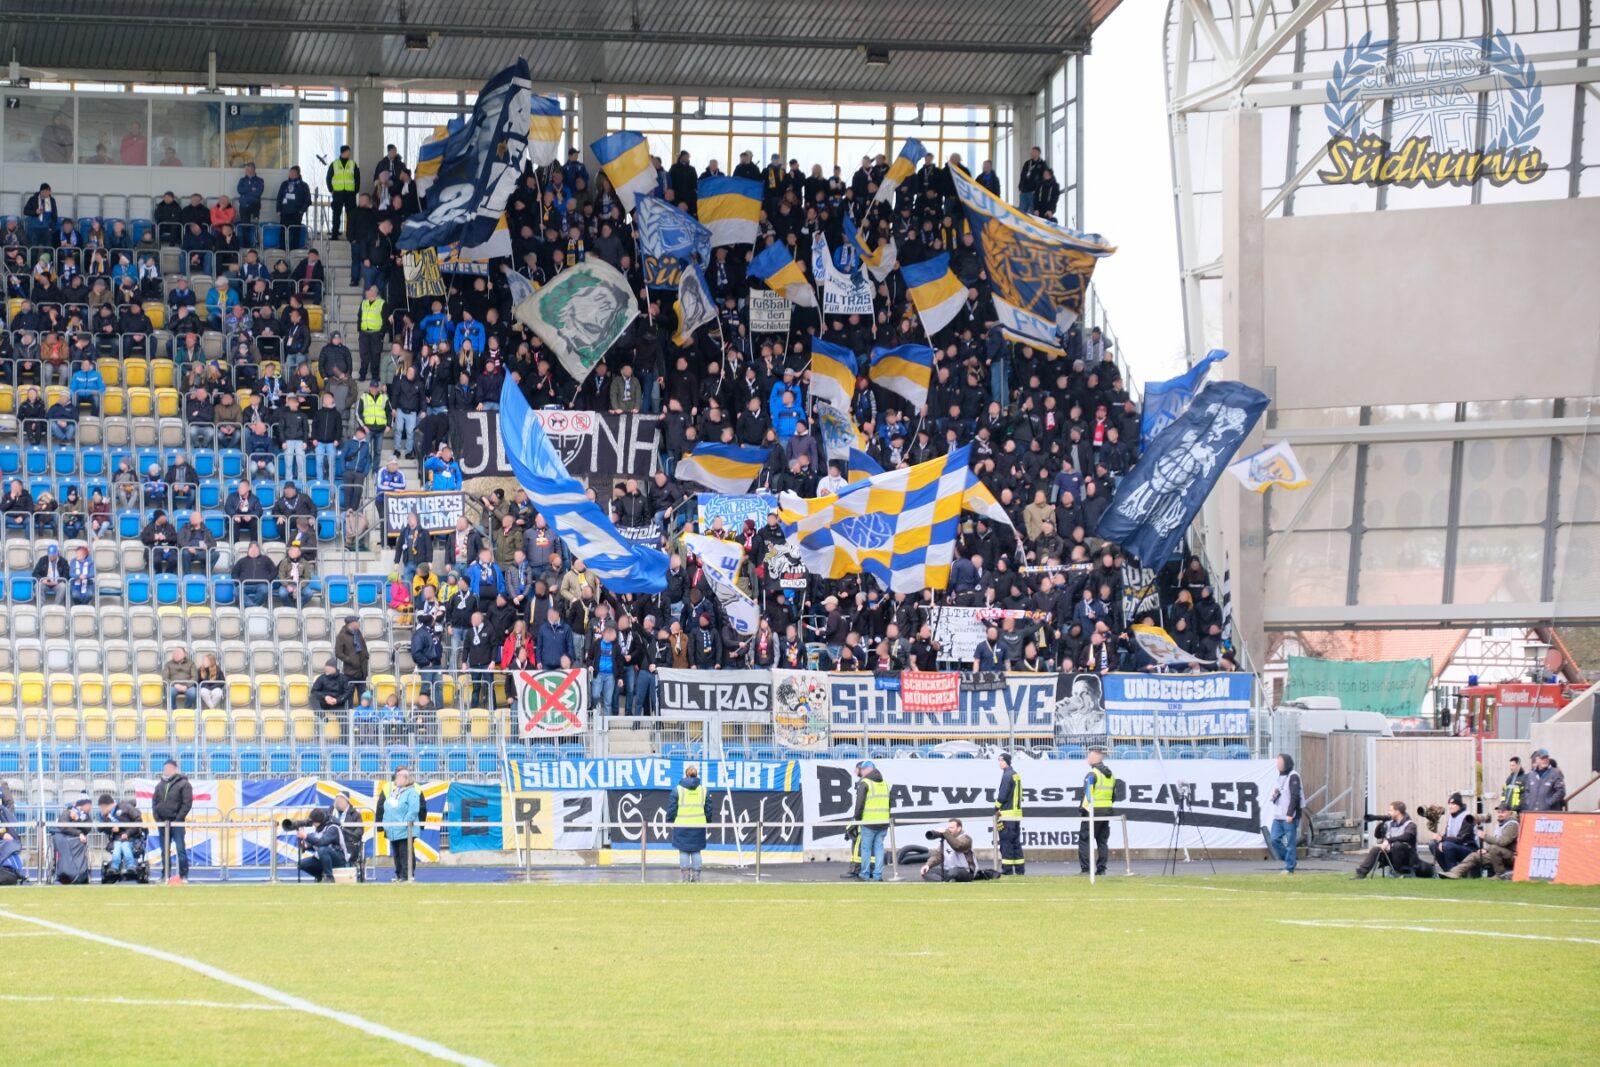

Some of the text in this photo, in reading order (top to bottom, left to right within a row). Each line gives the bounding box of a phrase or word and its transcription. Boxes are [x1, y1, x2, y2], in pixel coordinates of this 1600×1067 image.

[1362, 47, 1489, 88] CARL ZEISS
[9, 98, 17, 108] 7
[230, 105, 238, 115] 8
[1318, 135, 1546, 187] Südkurve
[753, 299, 790, 309] fußball
[825, 292, 871, 304] ULTRAS
[767, 311, 784, 319] den
[388, 495, 462, 513] REFUGEES
[663, 683, 769, 710] ULTRAS
[904, 691, 956, 704] MÜNCHEN
[1124, 678, 1230, 700] UNBEUGSAM
[1109, 713, 1247, 737] UNVERKÄUFLICH
[524, 761, 670, 788] SÜDKURVE
[617, 792, 796, 842] Safeld
